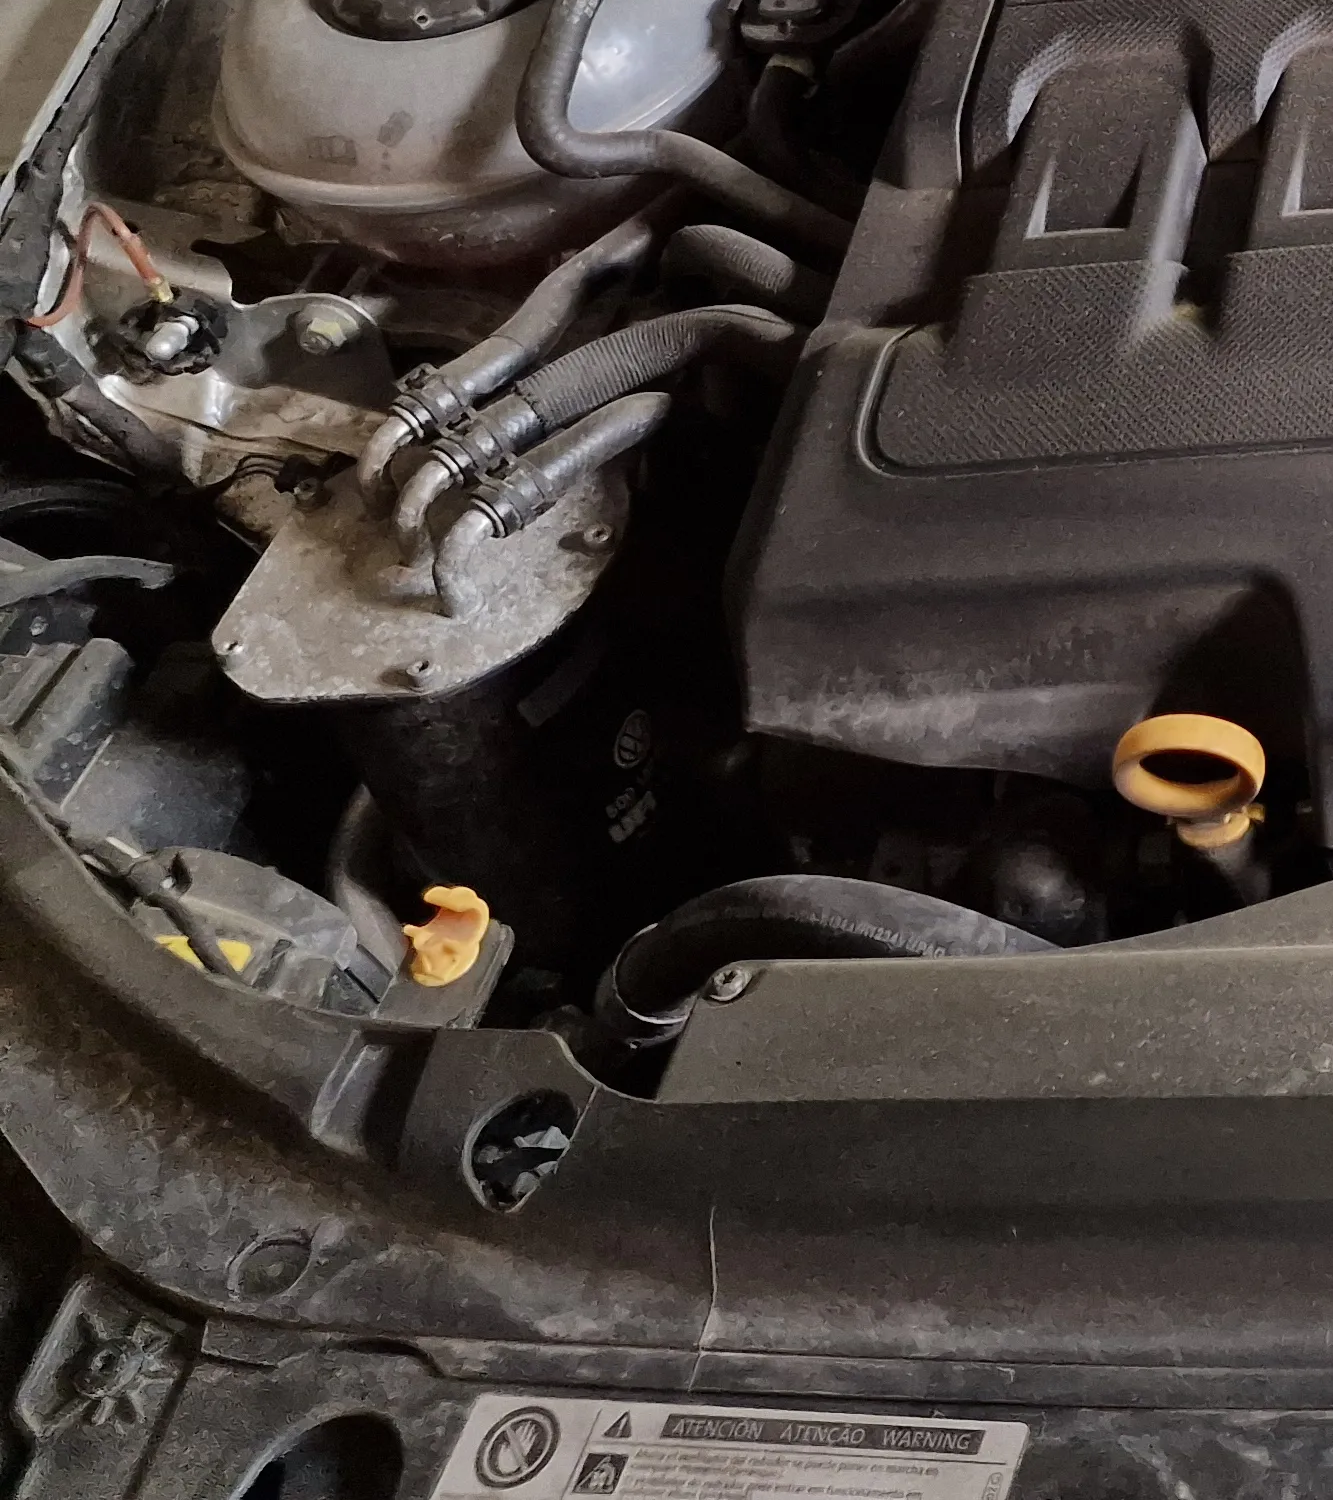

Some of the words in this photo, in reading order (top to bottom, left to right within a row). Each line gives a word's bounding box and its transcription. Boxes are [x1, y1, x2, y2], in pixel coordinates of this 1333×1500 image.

[671, 1417, 764, 1440] ATENCIÓN
[779, 1422, 866, 1447] ATENÇÃO
[882, 1428, 972, 1451] WARNING
